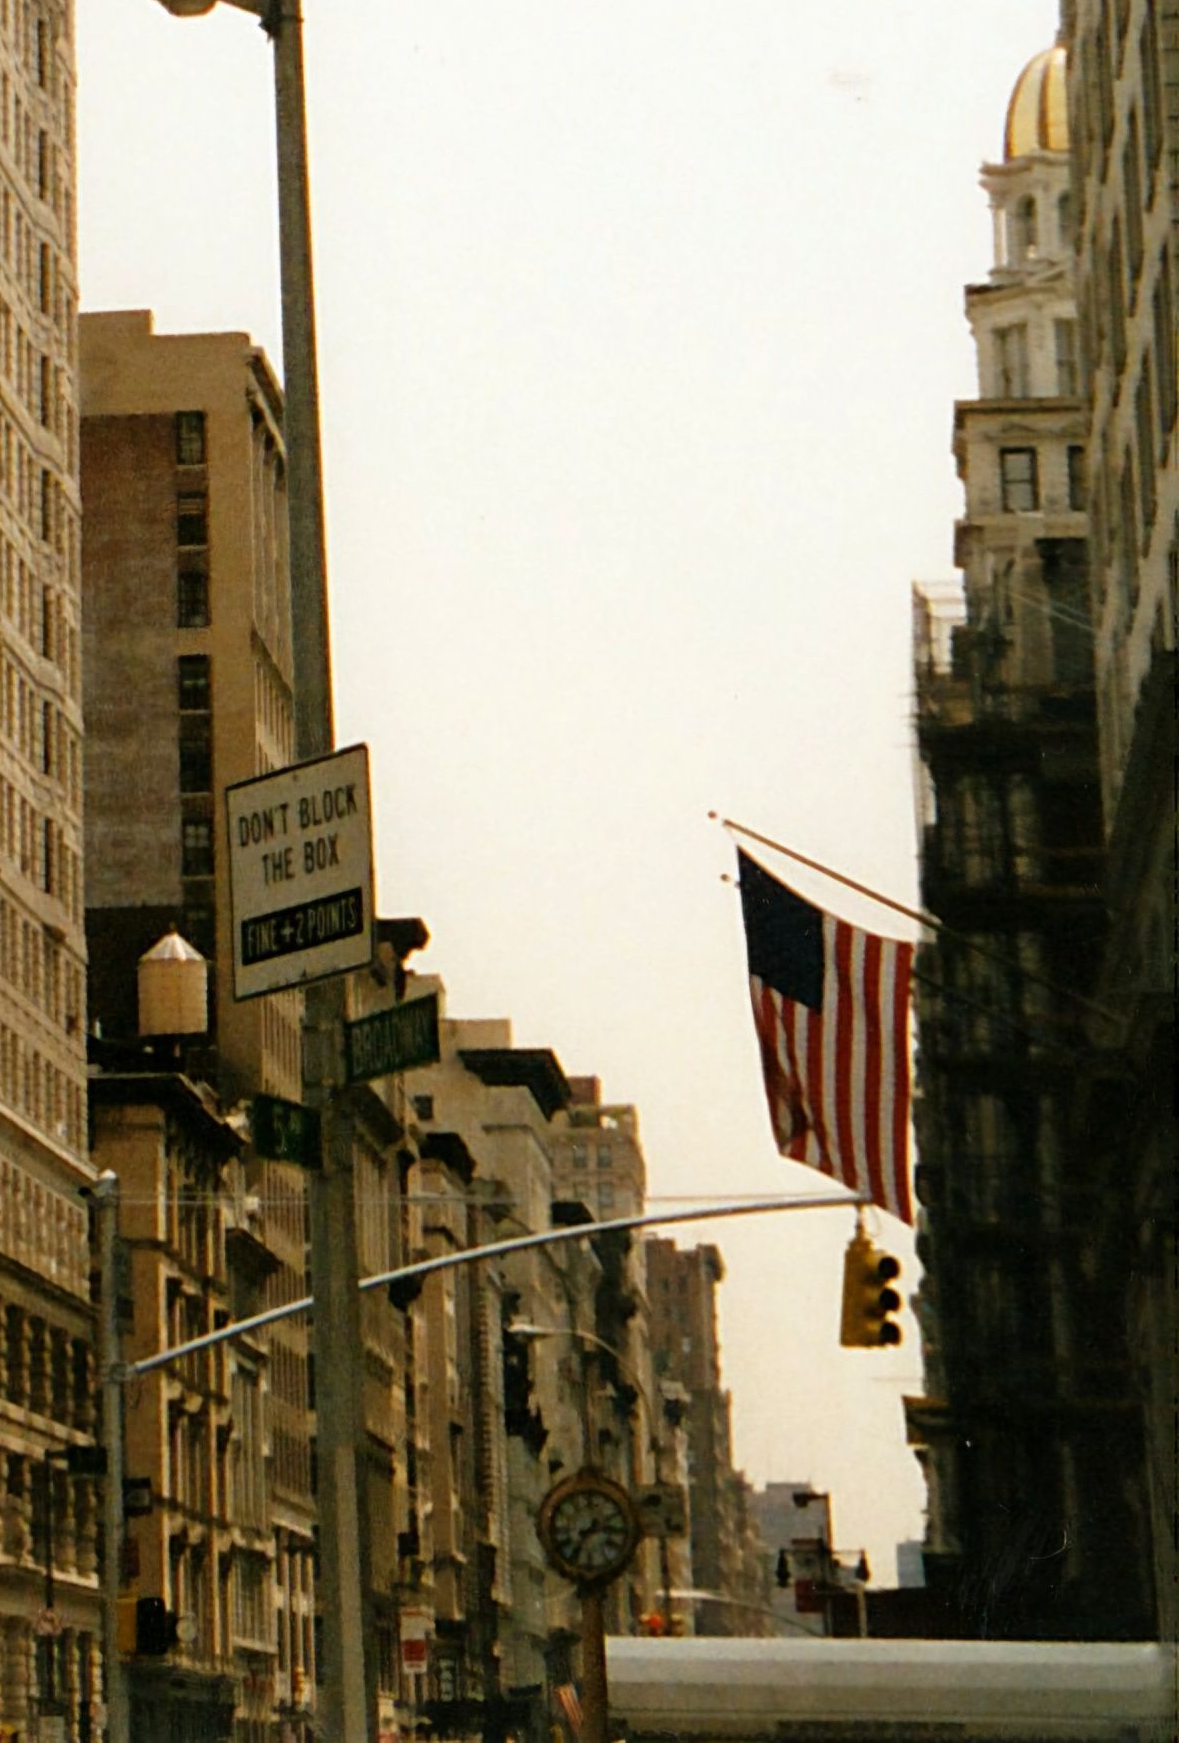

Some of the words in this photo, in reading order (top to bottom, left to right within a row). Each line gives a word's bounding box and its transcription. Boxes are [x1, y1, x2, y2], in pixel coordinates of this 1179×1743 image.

[238, 802, 289, 847] DON'T
[299, 784, 358, 830] BLOCK
[262, 847, 295, 885] THE
[304, 832, 340, 874] BOX
[247, 918, 278, 959] FINE
[307, 895, 359, 945] POINTS
[352, 1006, 430, 1076] BROADWAY
